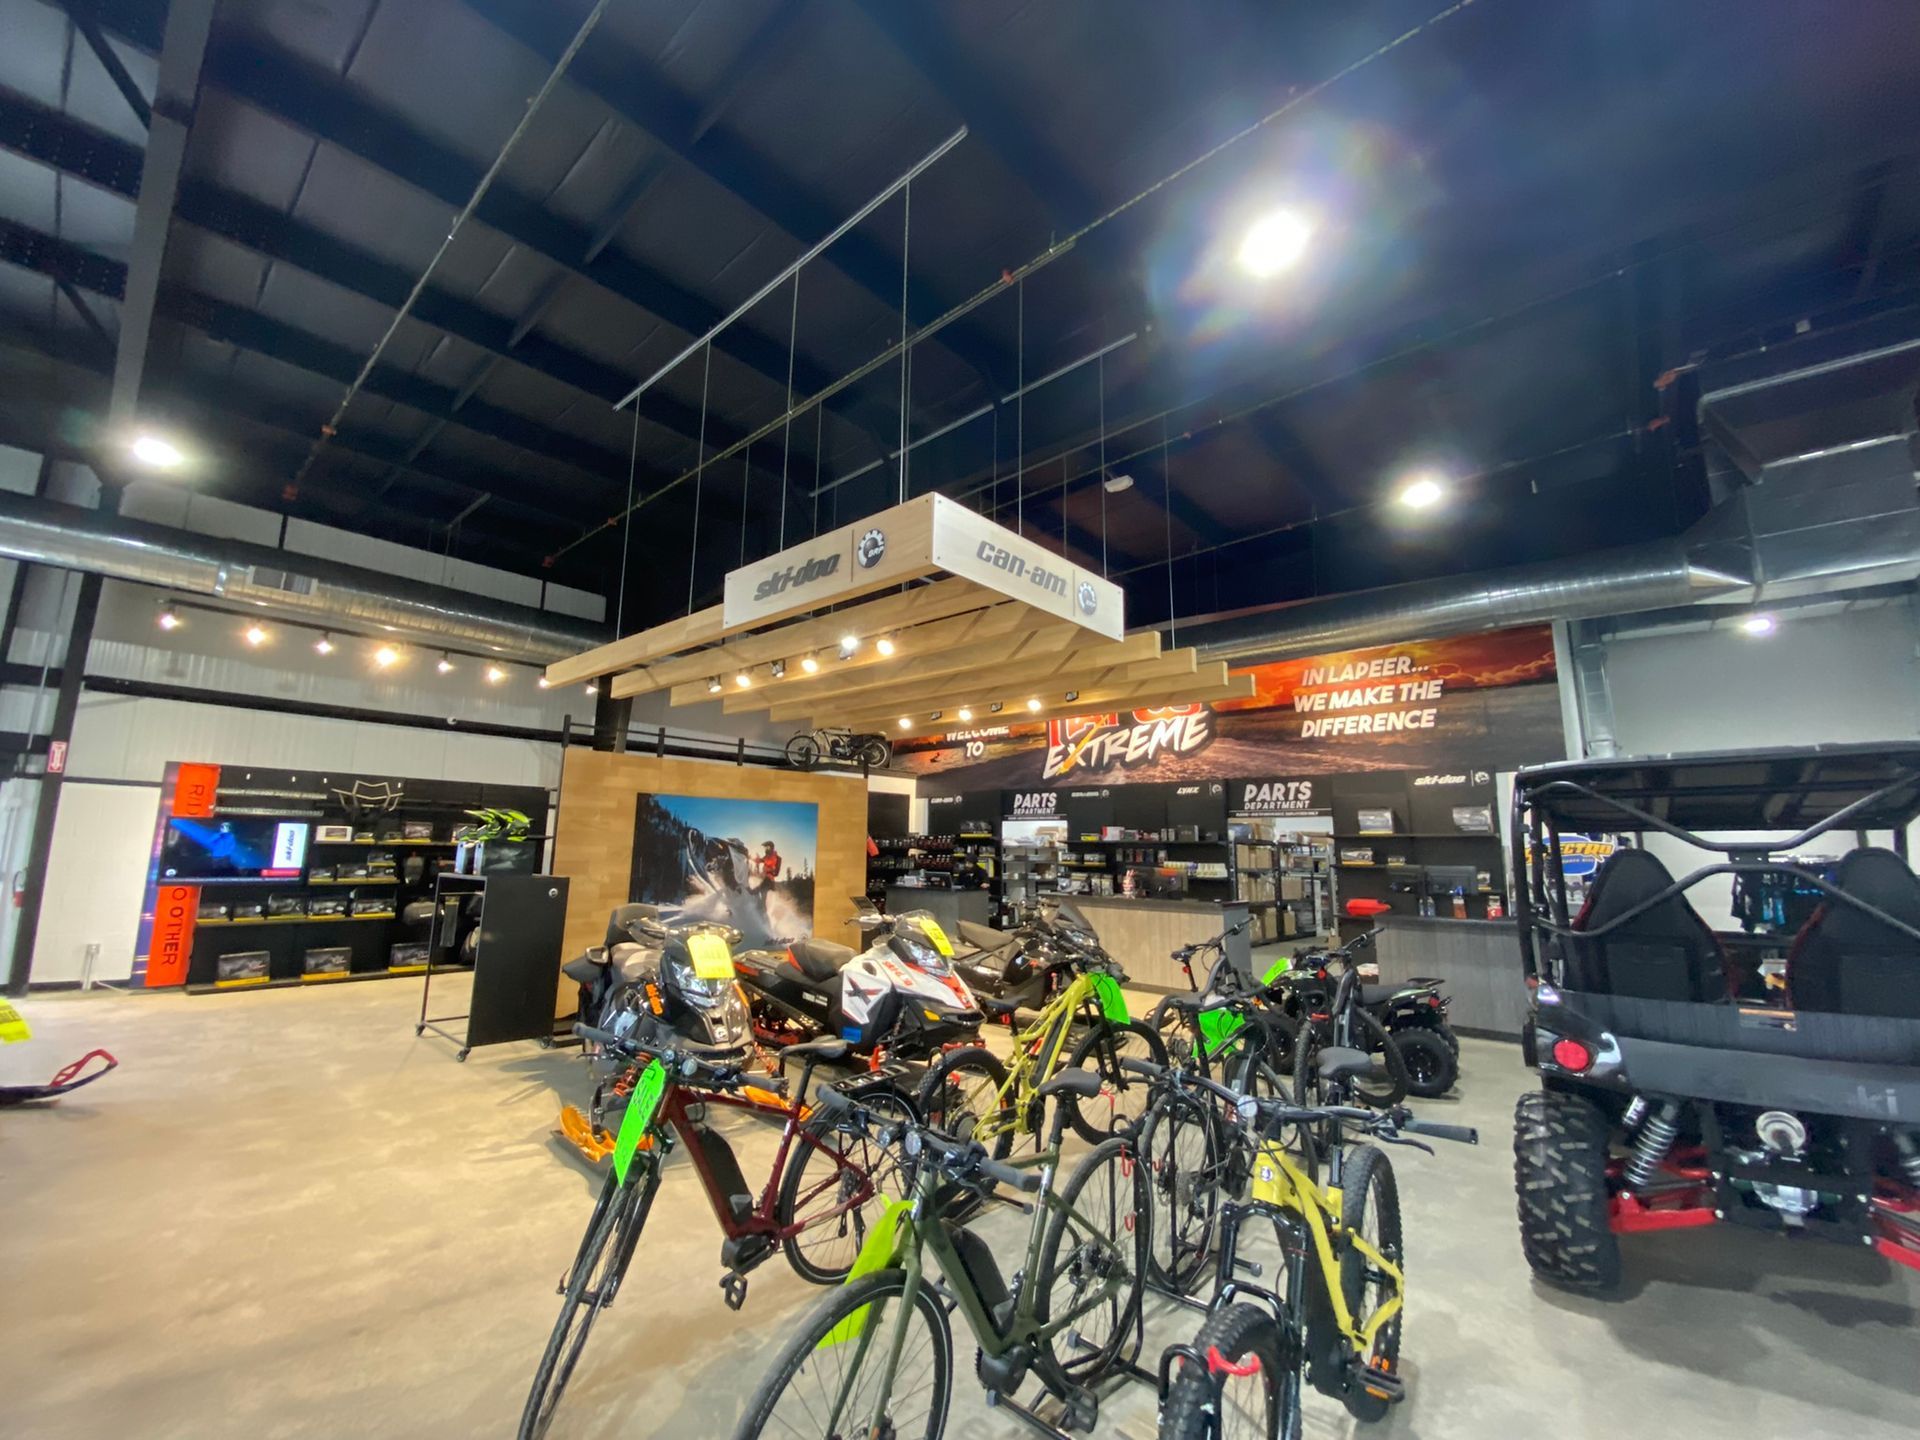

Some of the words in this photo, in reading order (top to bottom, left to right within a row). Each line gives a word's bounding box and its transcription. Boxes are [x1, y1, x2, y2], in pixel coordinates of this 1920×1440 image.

[753, 553, 841, 601] ski-doo
[976, 540, 1068, 598] can-am
[1302, 667, 1325, 687] IN
[1327, 656, 1429, 684] LAPEER...
[1294, 693, 1327, 713] WE
[1328, 685, 1395, 710] MAKE
[1399, 679, 1444, 702] THE
[1301, 708, 1437, 738] DIFFERENCE
[966, 741, 984, 758] TO
[1043, 710, 1209, 780] EXTREME
[1013, 792, 1057, 808] PARTS
[1243, 781, 1312, 802] PARTS
[1244, 800, 1311, 810] DEPARTMENT
[1013, 807, 1055, 815] DEPARTMENT
[161, 906, 184, 966] OTHER
